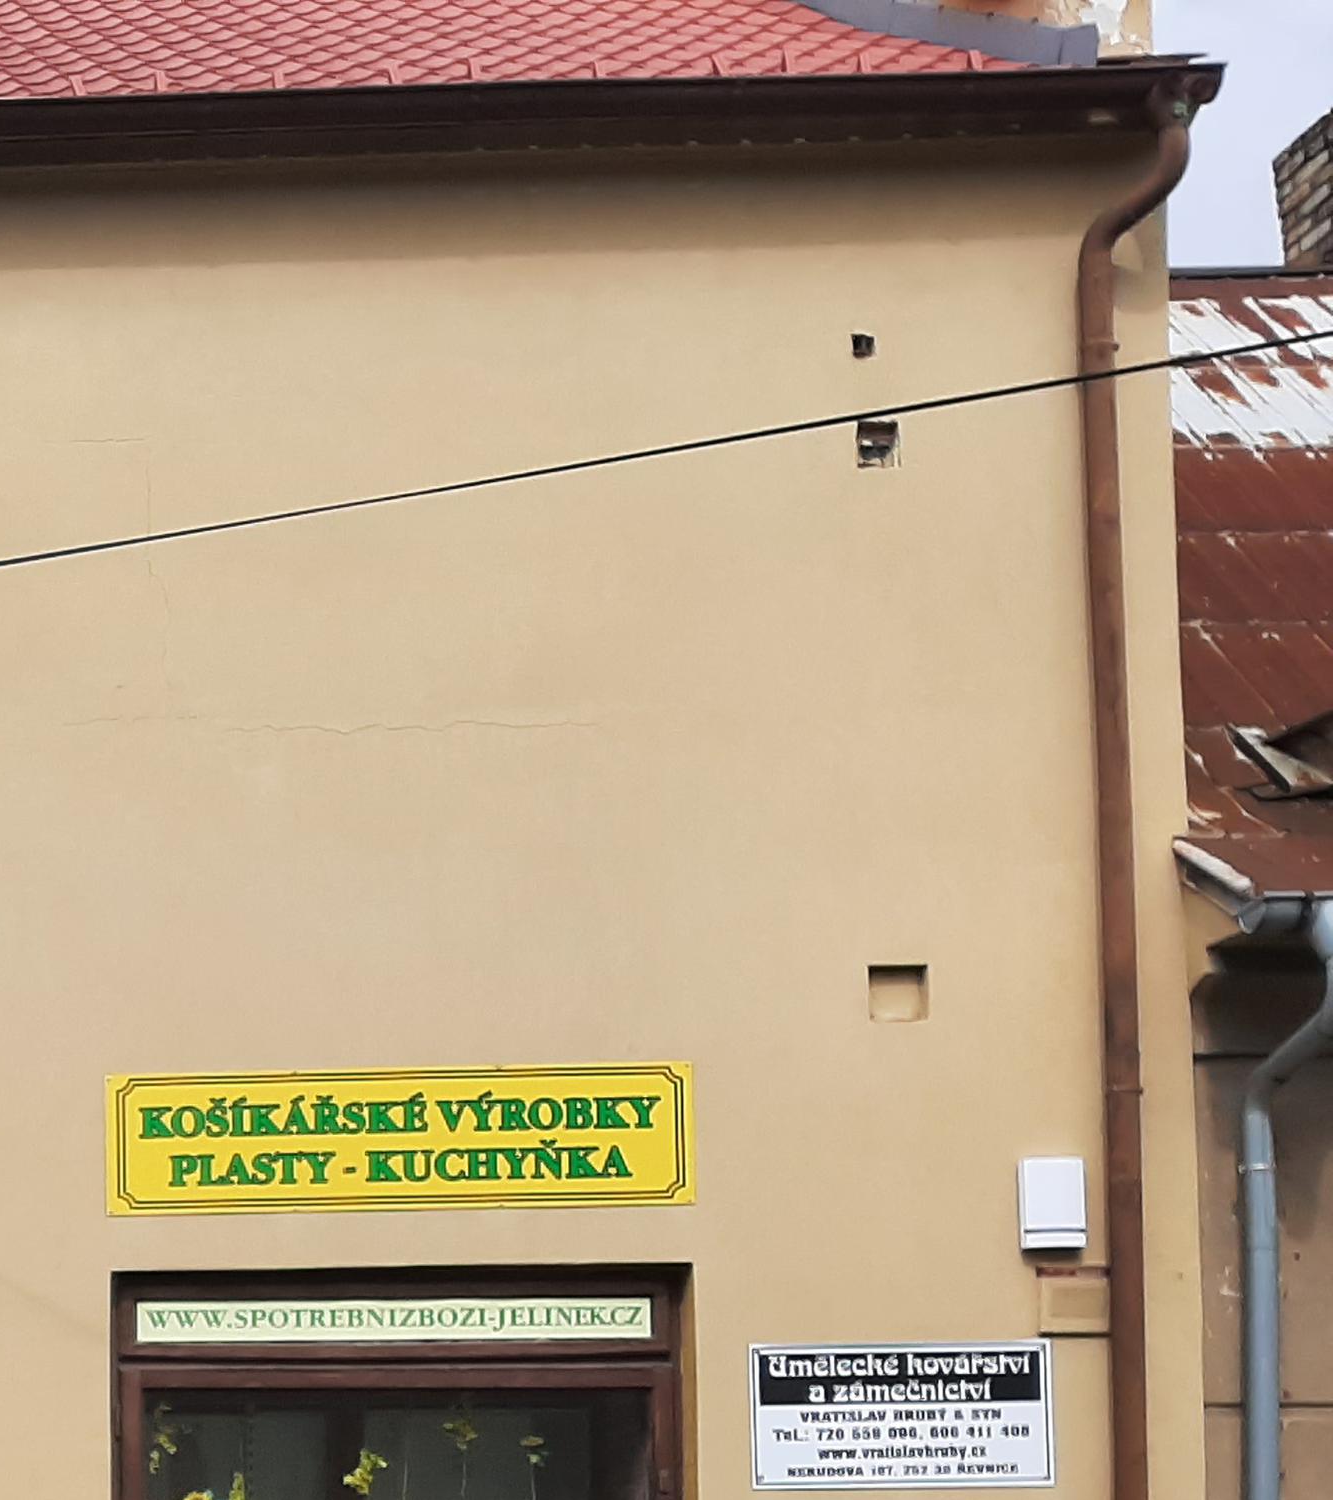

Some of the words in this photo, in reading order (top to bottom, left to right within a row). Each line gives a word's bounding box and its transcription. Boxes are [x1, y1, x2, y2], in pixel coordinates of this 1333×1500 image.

[139, 1092, 428, 1140] KOŠÍKÁŘSKÉ
[437, 1091, 660, 1132] VÝROBKY
[168, 1151, 336, 1187] PLASTY
[365, 1140, 633, 1183] KUCHYŇKA
[145, 1306, 643, 1331] WWW.SPOTREBNIZBOZI-JELINEK.CZ
[768, 1353, 899, 1378] Umělecké
[907, 1351, 1031, 1377] kovářství
[808, 1384, 826, 1402] a
[833, 1378, 993, 1403] zámečnictví
